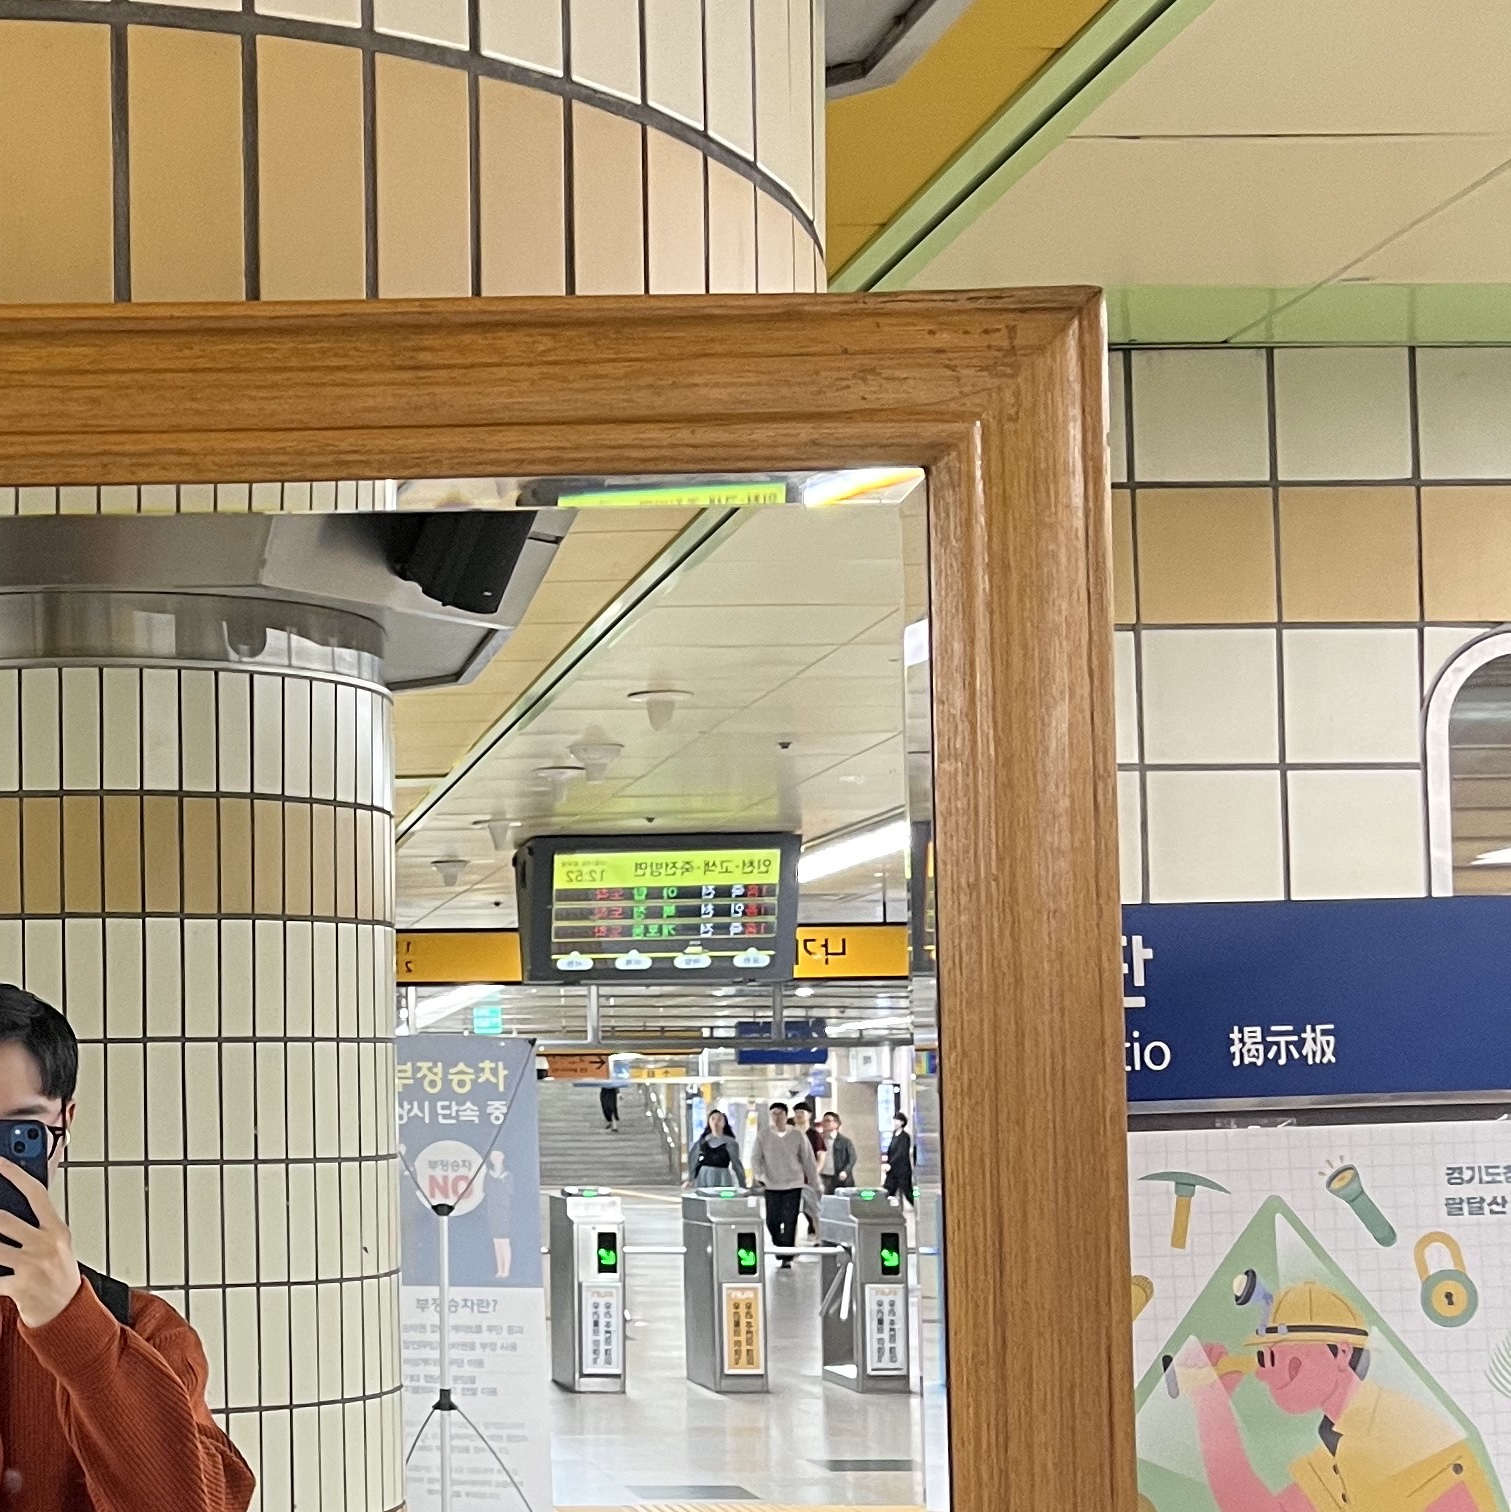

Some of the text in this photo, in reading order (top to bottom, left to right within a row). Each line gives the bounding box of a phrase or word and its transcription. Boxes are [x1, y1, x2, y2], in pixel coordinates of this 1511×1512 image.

[1229, 1023, 1336, 1067] 揭示板
[397, 1060, 508, 1094] 부정승차
[437, 1100, 480, 1124] 단속
[486, 1100, 508, 1125] 중
[428, 1159, 472, 1172] 부정승차
[428, 1175, 474, 1200] NO
[1444, 1195, 1508, 1216] 팔달산
